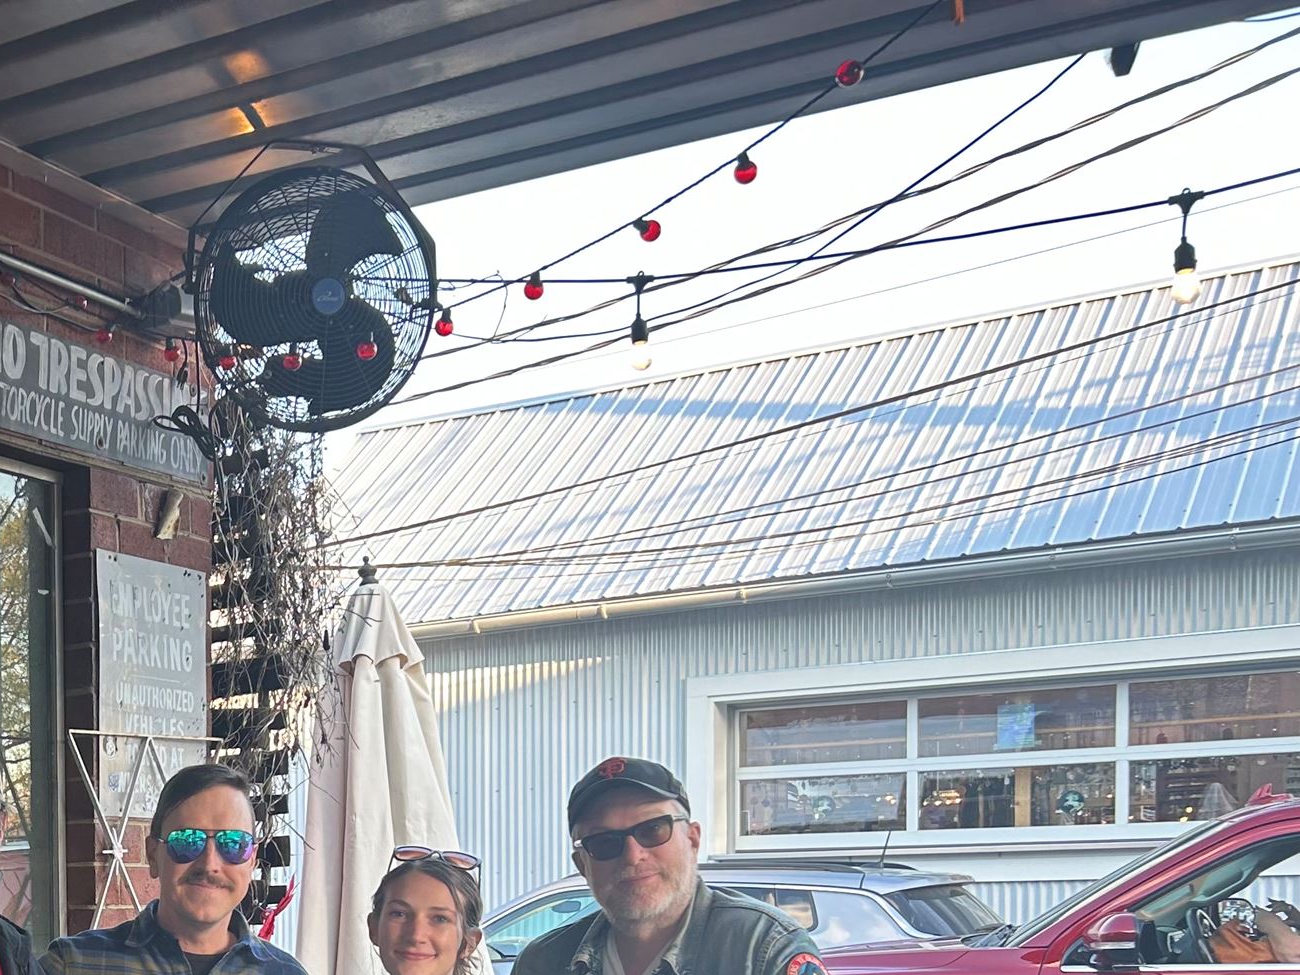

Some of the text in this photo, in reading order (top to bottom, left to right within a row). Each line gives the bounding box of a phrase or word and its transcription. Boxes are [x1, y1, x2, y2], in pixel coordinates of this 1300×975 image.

[71, 404, 113, 450] SUPPLY
[116, 418, 167, 465] PARKING
[170, 434, 201, 476] ONLY
[109, 580, 190, 631] EMPLOYEE
[112, 626, 193, 673] PARKING
[115, 680, 195, 713] UNAUTHORIZED
